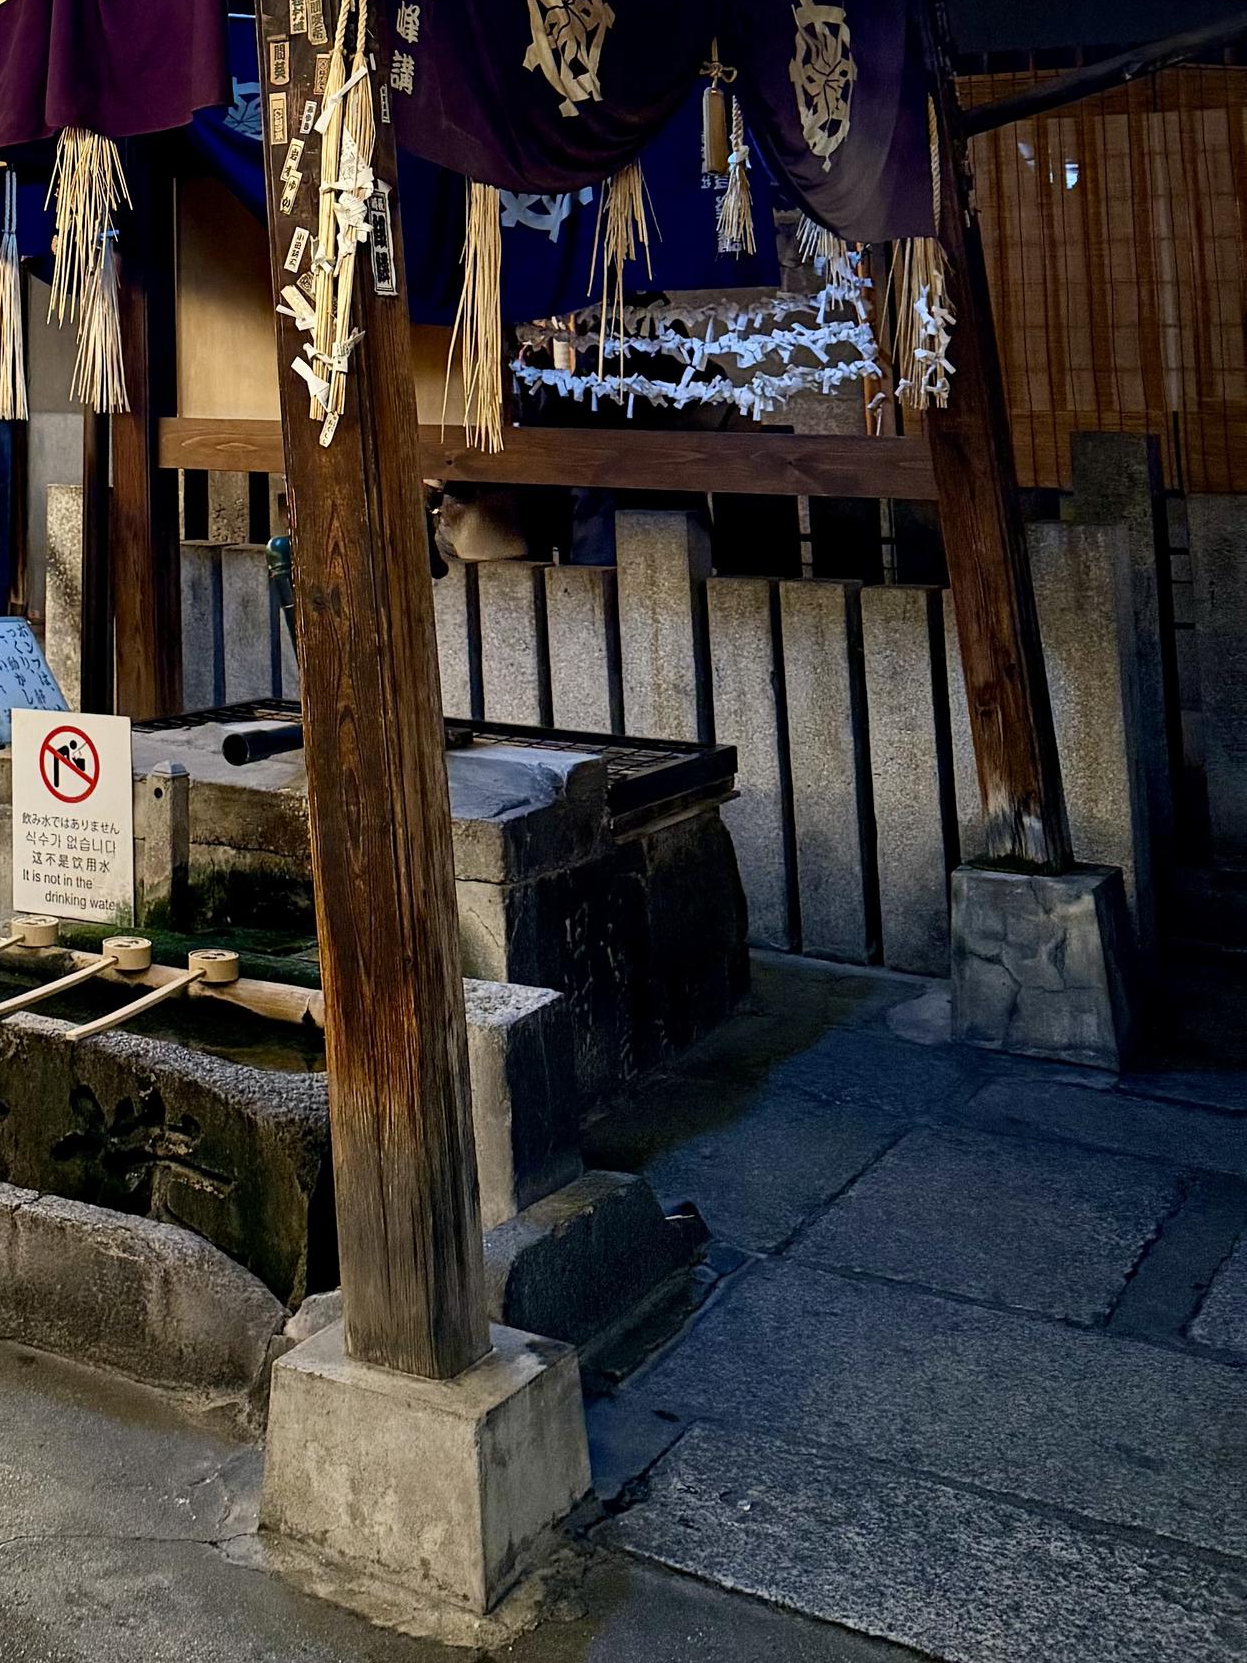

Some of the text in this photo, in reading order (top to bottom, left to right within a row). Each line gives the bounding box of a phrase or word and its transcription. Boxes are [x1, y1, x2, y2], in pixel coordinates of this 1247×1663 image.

[22, 812, 120, 834] 飲み水ではありません
[25, 831, 116, 856] 식수가 없습니다
[33, 850, 110, 873] 这不是饮用水
[22, 869, 93, 889] It is not in the
[45, 890, 116, 911] drinking wate
